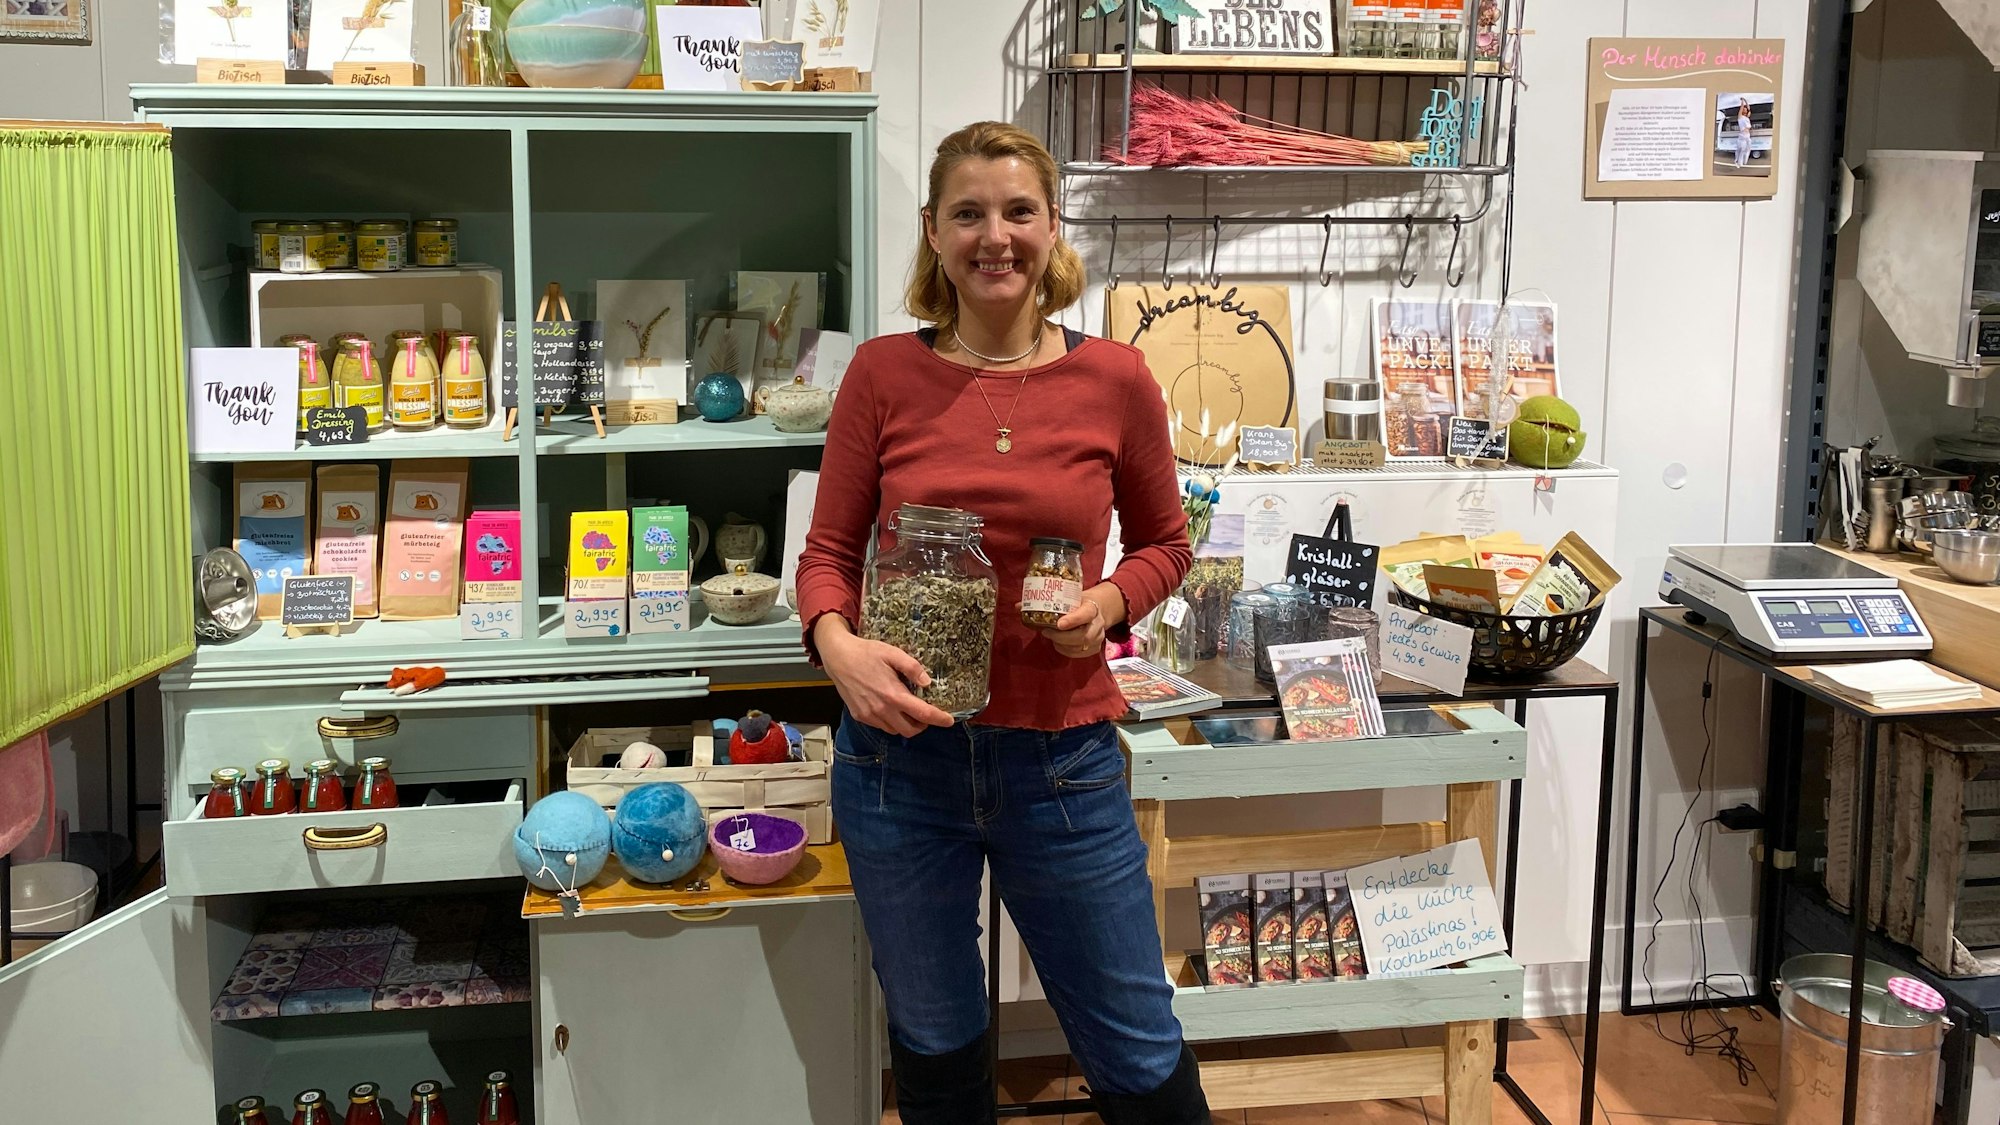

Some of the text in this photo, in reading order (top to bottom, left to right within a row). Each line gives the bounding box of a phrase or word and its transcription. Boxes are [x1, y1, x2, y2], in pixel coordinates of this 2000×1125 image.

[1188, 9, 1324, 50] LEBENS
[673, 35, 742, 58] Thank
[699, 53, 741, 74] You
[1601, 45, 1782, 69] Der Mensch dahinter
[217, 69, 262, 83] BioZisch
[351, 73, 391, 86] BioZisch
[1466, 336, 1533, 354] UNER
[1468, 354, 1533, 372] PAKT
[204, 381, 276, 408] Thank
[448, 399, 483, 408] DRESSING
[227, 402, 274, 427] You
[316, 409, 346, 419] Emils
[394, 401, 431, 411] DRESSING
[311, 419, 354, 434] Dressing
[325, 541, 366, 549] glutenfreie
[583, 550, 616, 558] fairafric
[645, 543, 677, 552] fairafric
[478, 553, 512, 561] fairafric
[1043, 578, 1064, 592] FAIRE
[1302, 566, 1351, 589] gläser
[471, 608, 514, 629] 2,99€
[575, 607, 619, 624] 2,99€
[639, 600, 684, 619] 2,99€
[1386, 631, 1461, 664] jedes Gewürz
[1363, 860, 1455, 900] Entdecke
[1374, 883, 1476, 927] die Küche
[1379, 940, 1456, 974] Kochbuch
